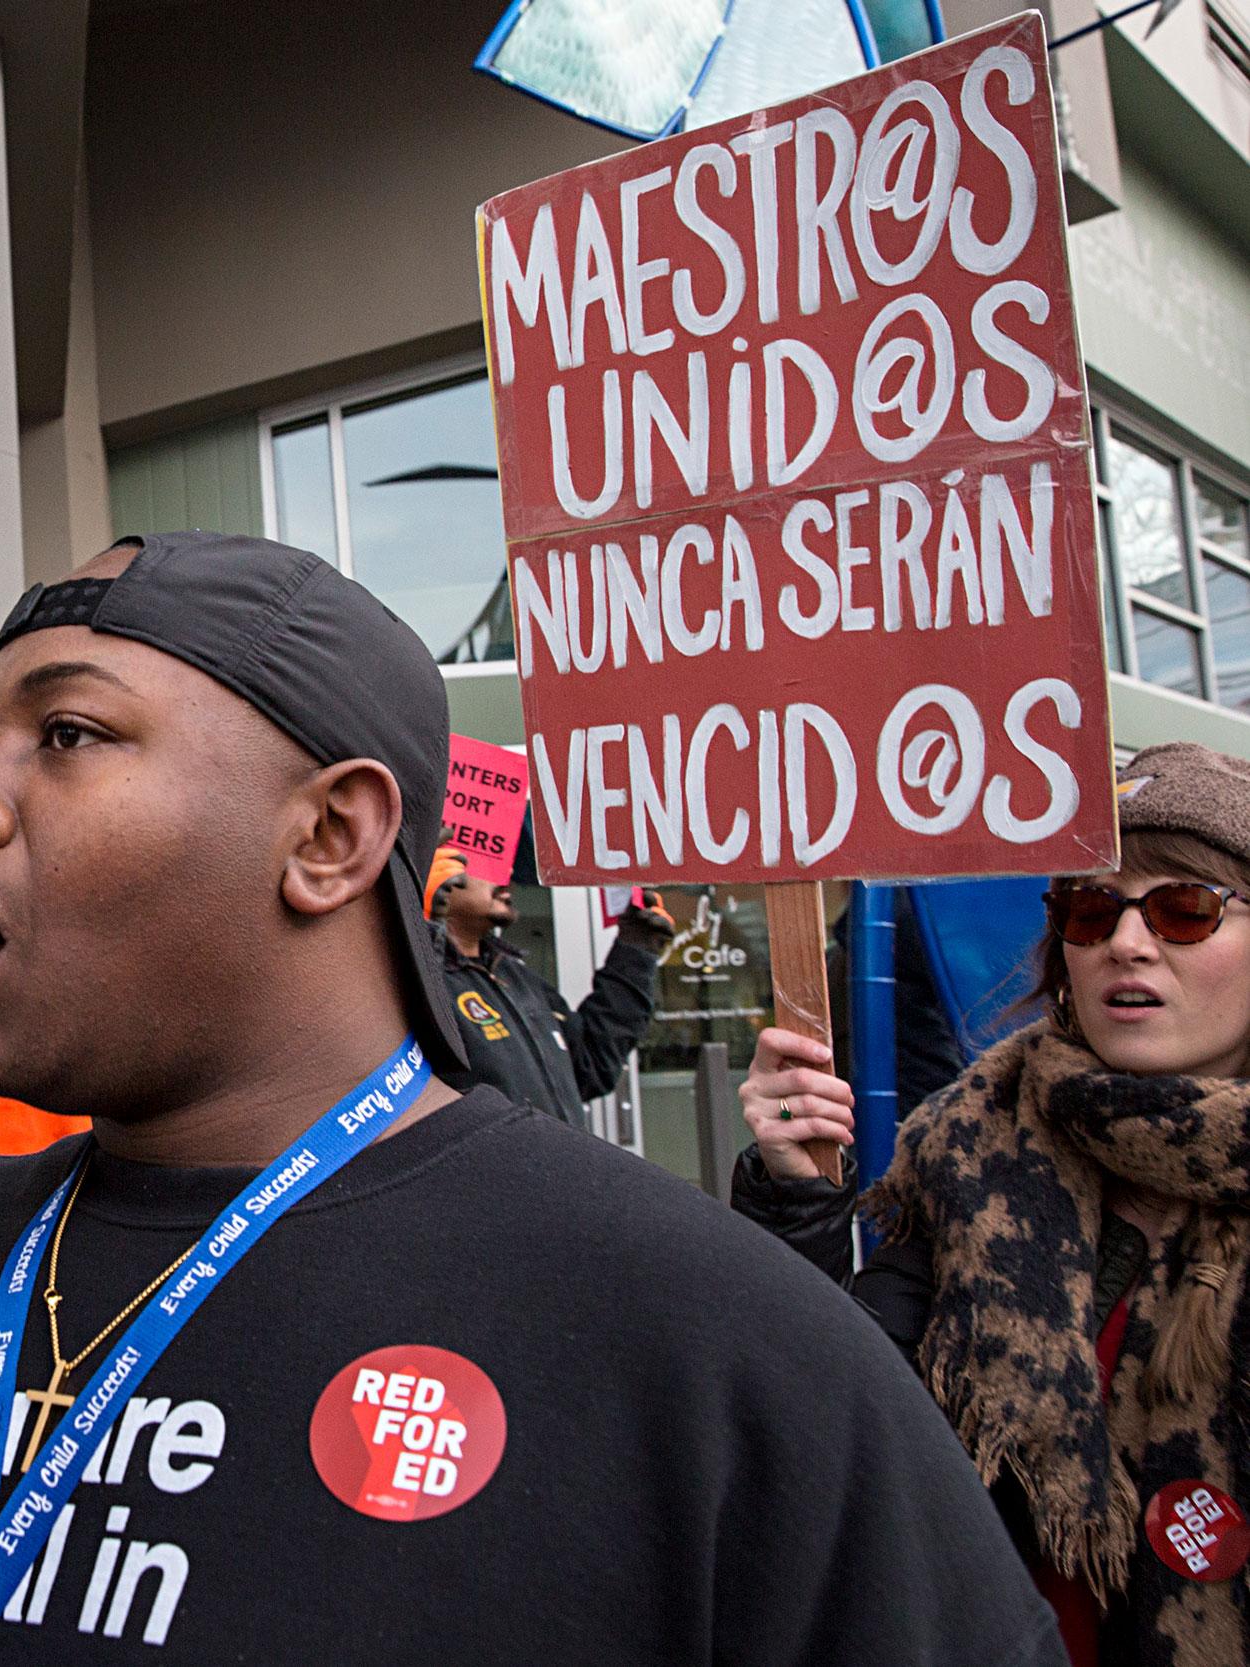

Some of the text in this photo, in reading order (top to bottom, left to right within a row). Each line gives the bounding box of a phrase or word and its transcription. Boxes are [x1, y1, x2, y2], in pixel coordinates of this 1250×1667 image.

[490, 45, 1039, 385] MAESTR@S
[513, 461, 1053, 679] NUNCA SERÁN
[337, 1088, 394, 1135] Every
[384, 1057, 415, 1095] Child
[159, 1148, 320, 1316] Every Child Succeeds!
[40, 1434, 80, 1489] Child
[73, 1345, 142, 1436] Succeeds!
[352, 1368, 446, 1413] RED
[372, 1409, 468, 1459] FOR
[391, 1451, 459, 1497] ED
[1191, 1487, 1225, 1525] ED
[1165, 1523, 1211, 1575] RED
[1173, 1495, 1218, 1549] FOR
[77, 1505, 190, 1646] in
